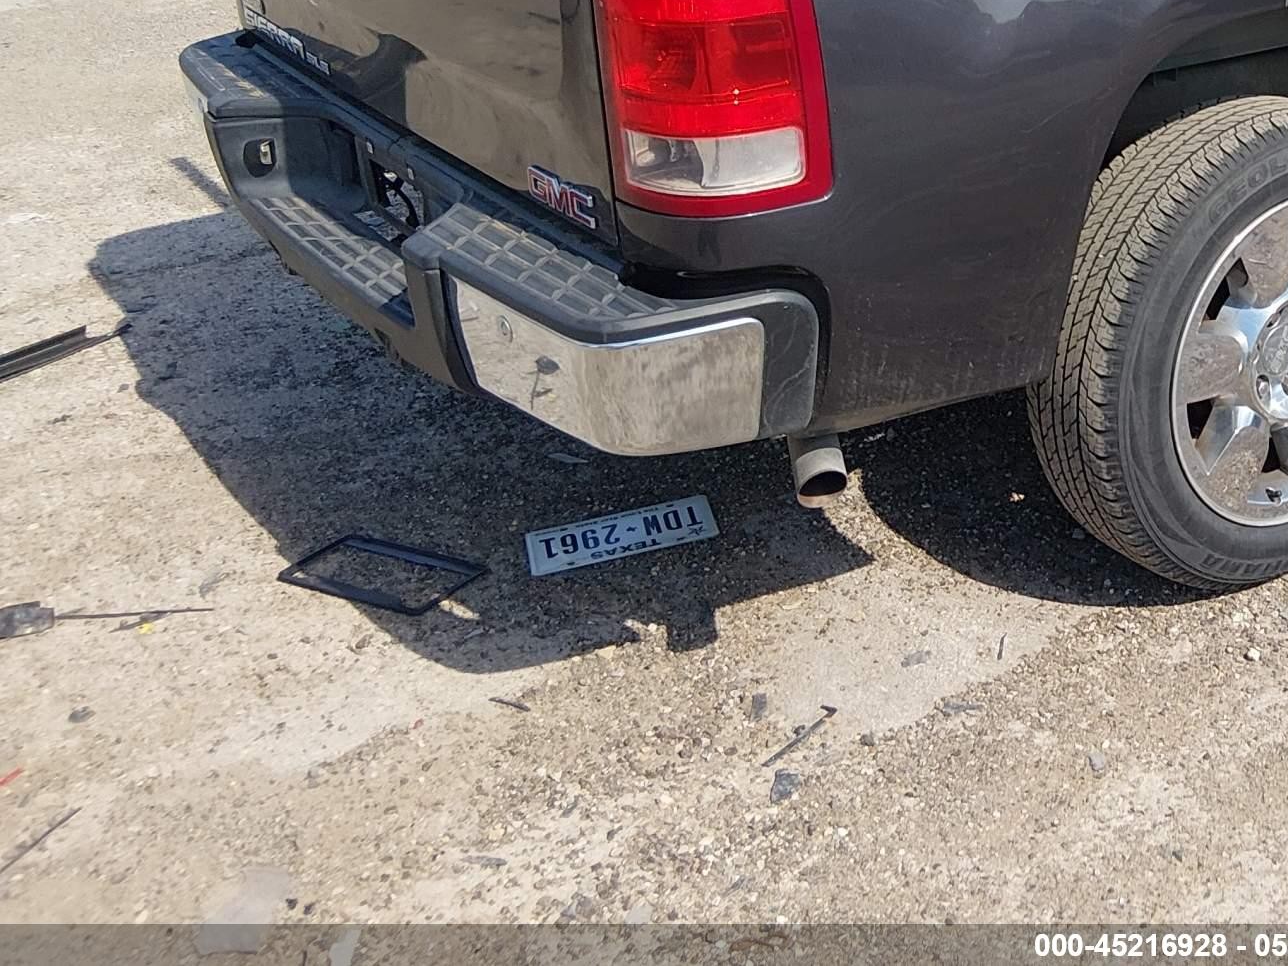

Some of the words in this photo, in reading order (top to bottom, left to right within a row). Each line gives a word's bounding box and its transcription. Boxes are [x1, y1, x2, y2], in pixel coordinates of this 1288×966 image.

[244, 8, 305, 60] SIERRA
[527, 165, 596, 230] GMC
[590, 538, 662, 560] TEXAS
